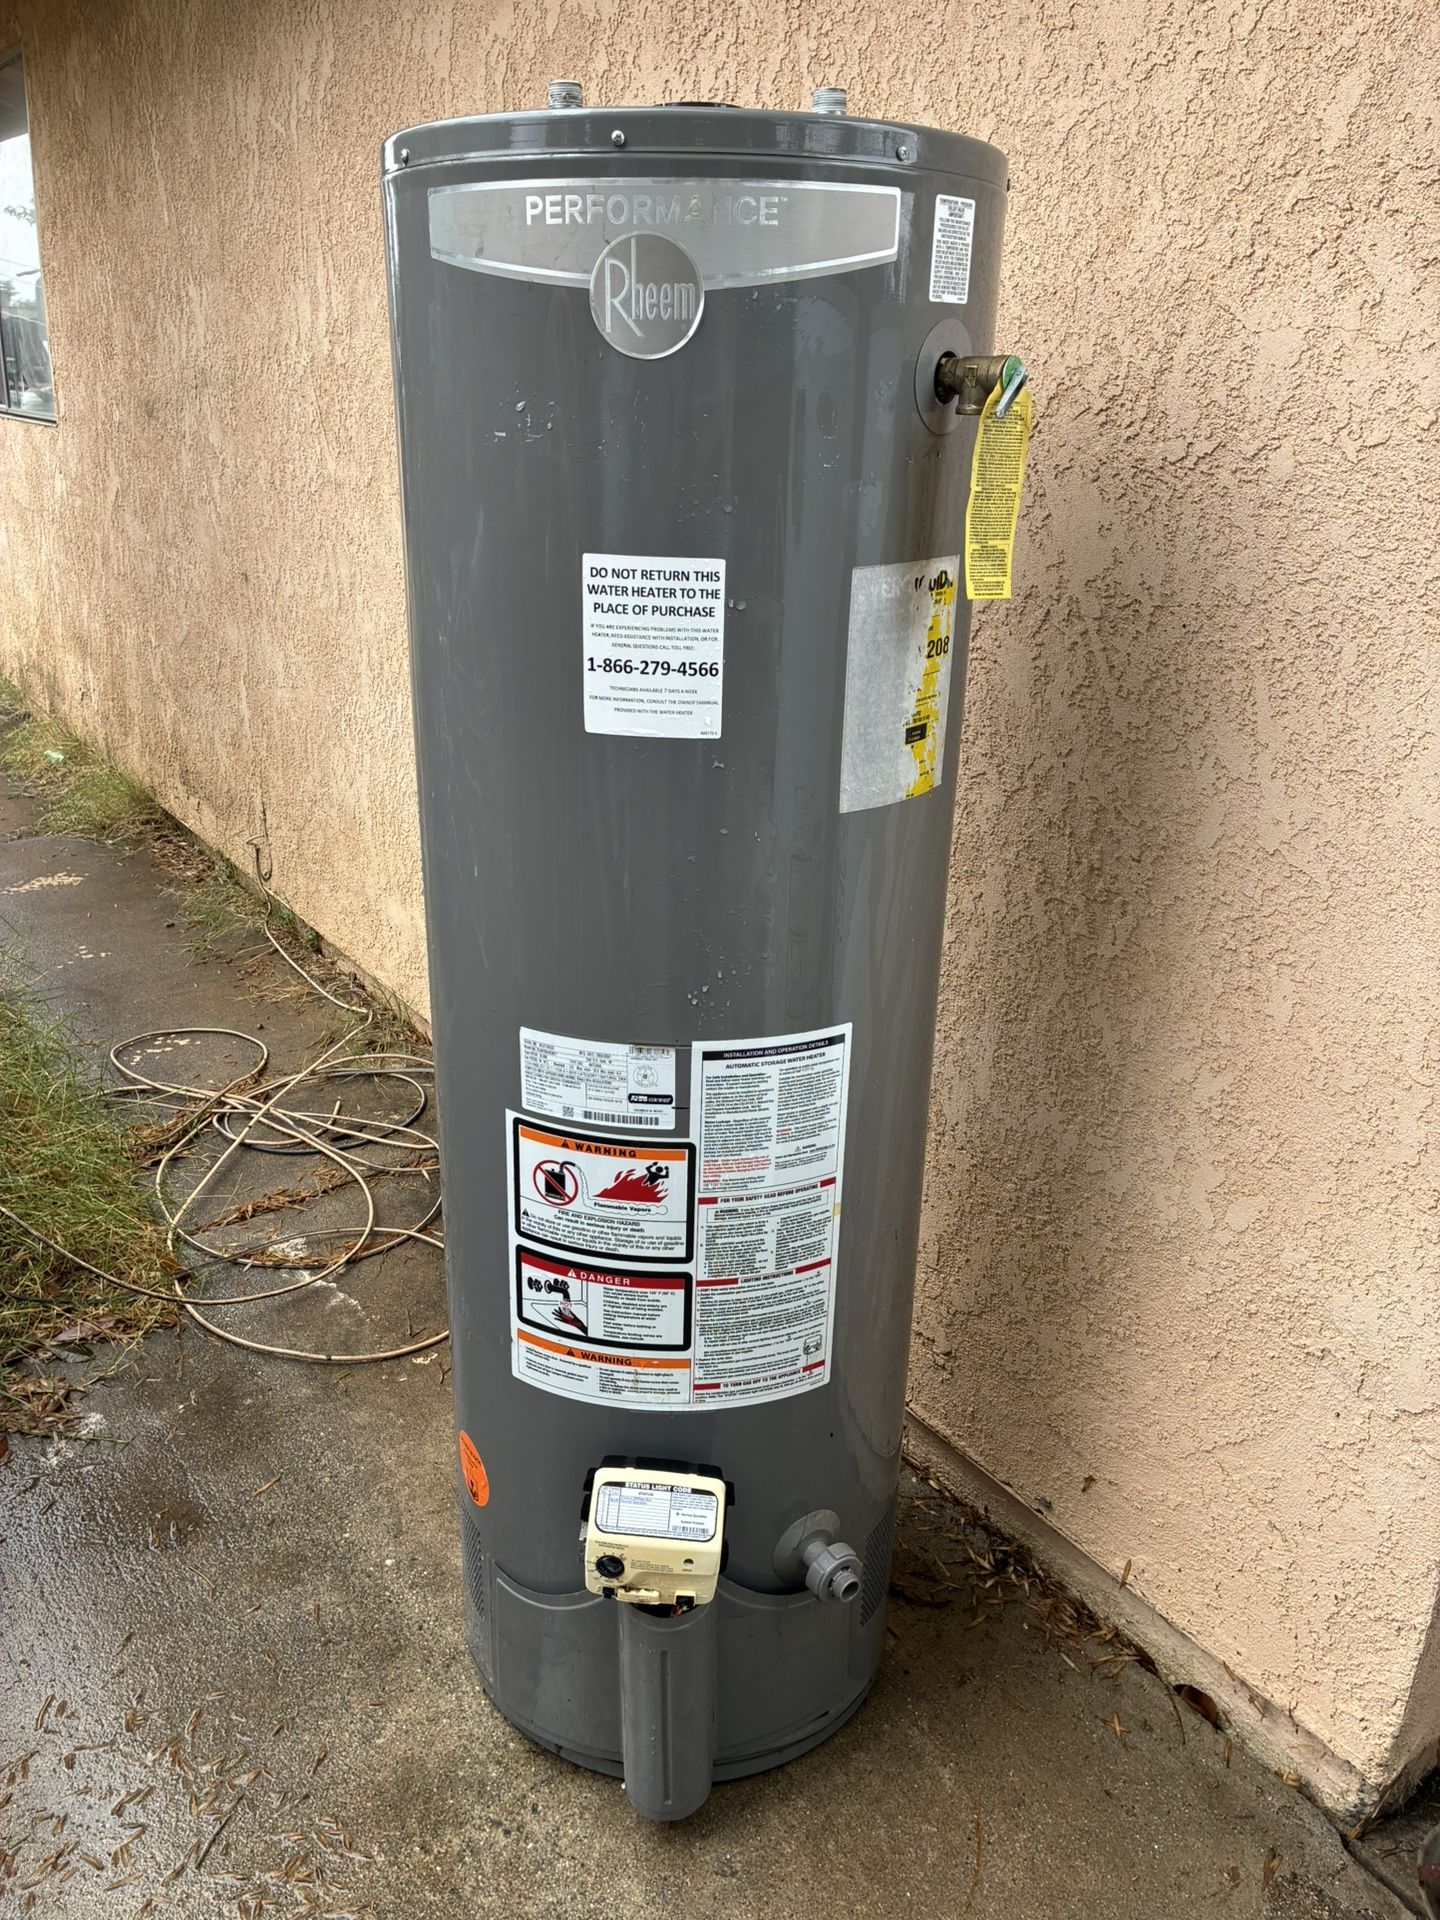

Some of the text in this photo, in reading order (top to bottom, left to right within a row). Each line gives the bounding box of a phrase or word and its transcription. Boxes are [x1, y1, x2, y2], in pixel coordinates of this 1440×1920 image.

[605, 237, 695, 337] Rheem
[590, 567, 720, 582] DO NOT RETURN THIS
[587, 584, 720, 599] WATER HEATER TO THE
[594, 603, 715, 617] PLACE OF PURCHASE
[587, 657, 719, 677] 1-866-279-4566
[723, 1050, 764, 1058] INSTALLATION
[778, 1045, 808, 1053] OPERATION
[809, 1040, 828, 1048] DETAILS
[761, 1058, 786, 1066] STORAGE
[806, 1052, 825, 1060] HEATER
[575, 1142, 636, 1158] WARNING
[594, 1201, 627, 1211] Flammable
[584, 1215, 615, 1224] EXPLOSION
[580, 1272, 630, 1286] DANGER
[581, 1352, 632, 1366] WARNING
[651, 1484, 671, 1492] LIGHT
